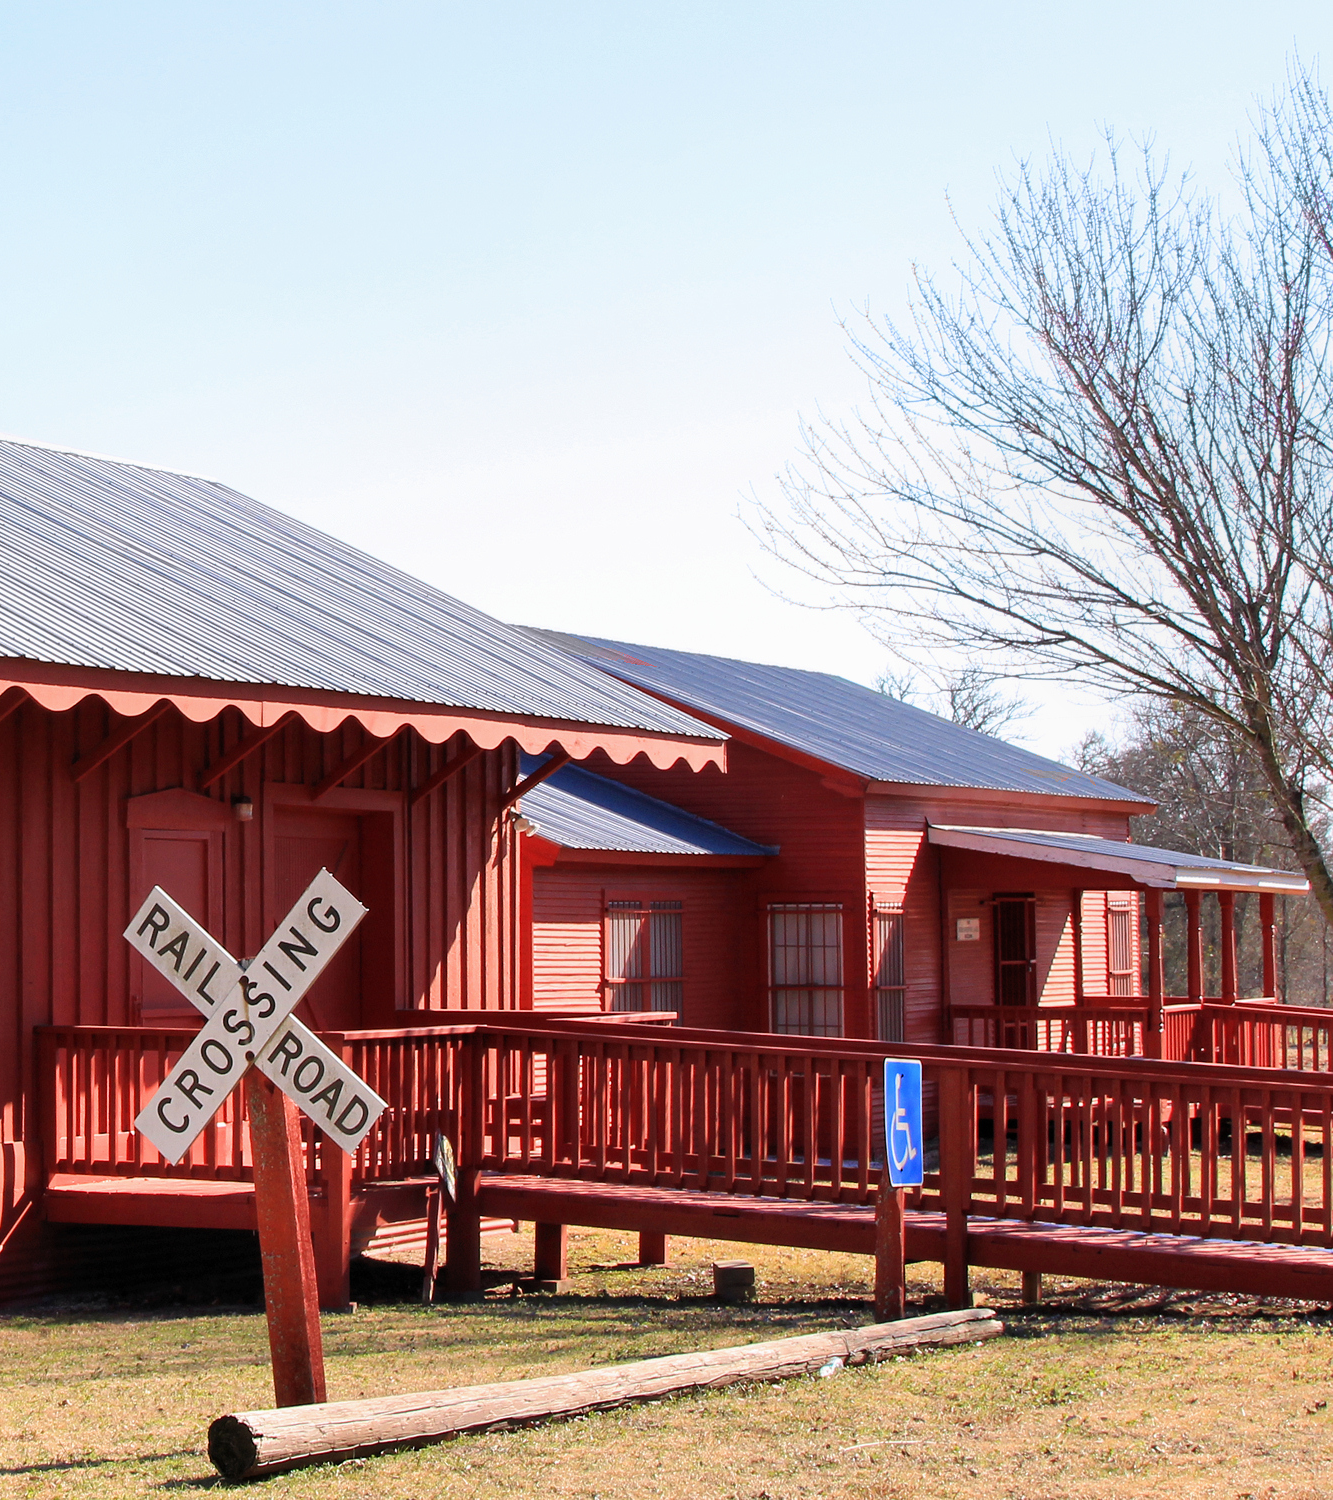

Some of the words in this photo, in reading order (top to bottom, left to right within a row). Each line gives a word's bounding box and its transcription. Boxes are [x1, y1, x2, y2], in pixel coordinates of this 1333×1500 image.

[136, 903, 221, 1006] RAIL
[267, 1030, 369, 1136] ROAD
[156, 897, 341, 1133] CROSSING
